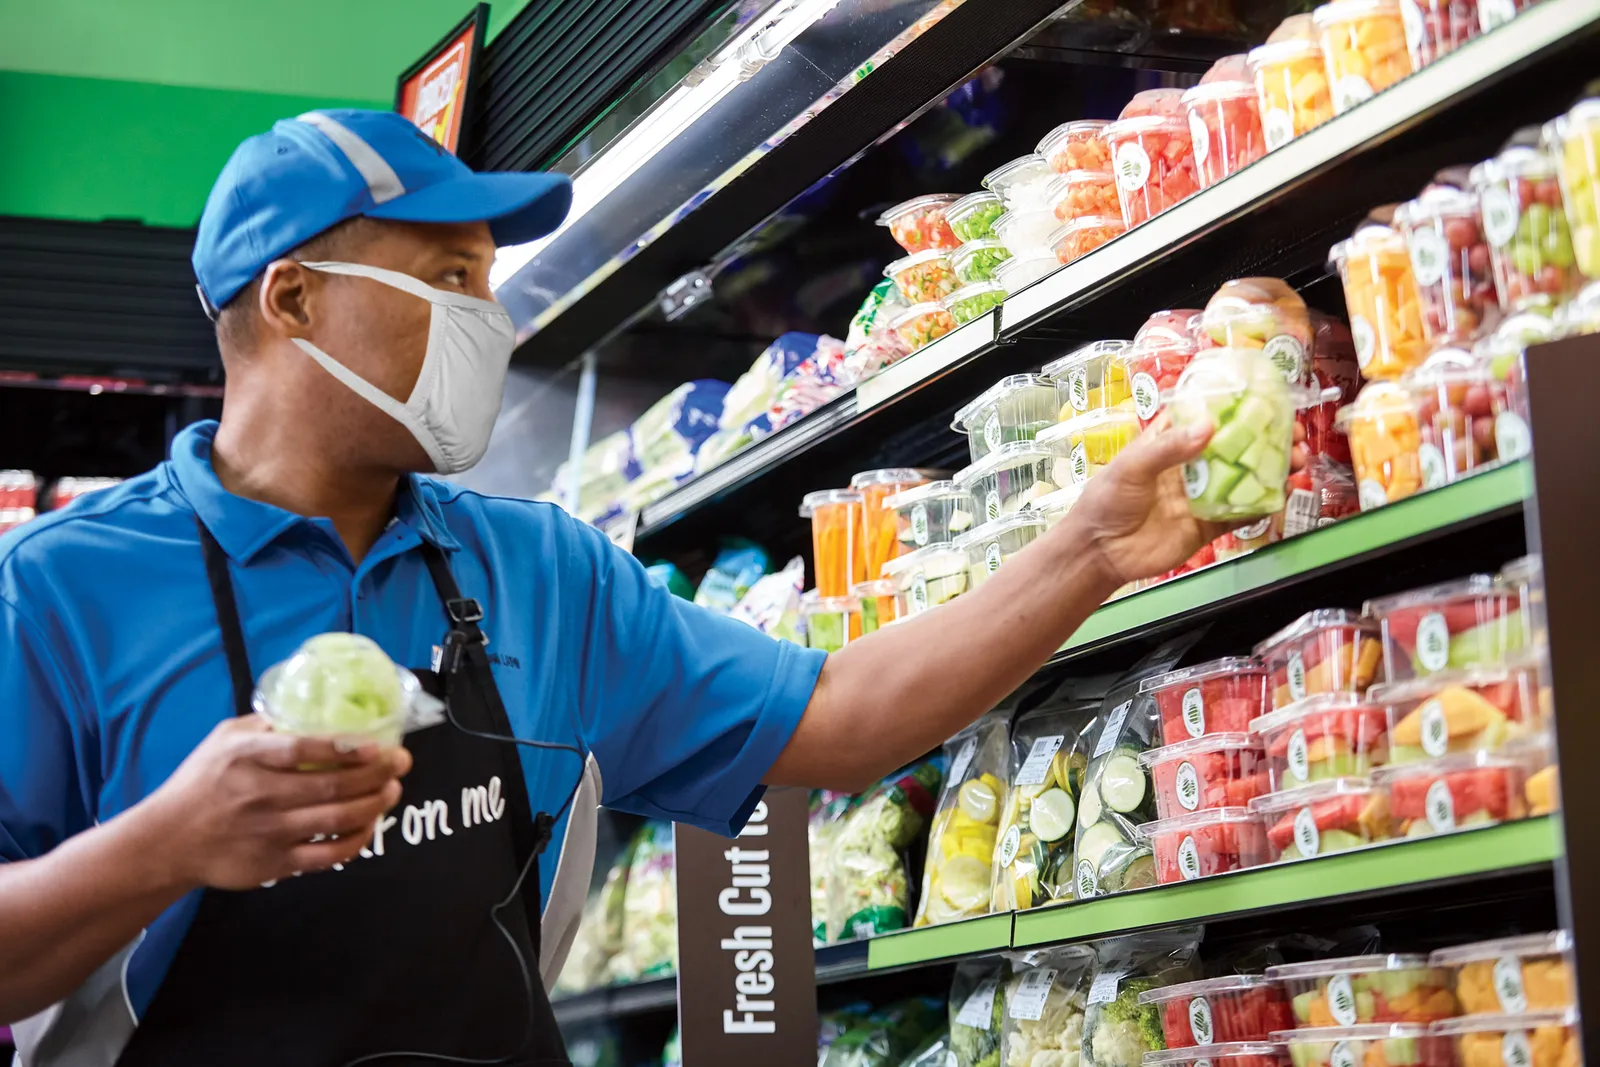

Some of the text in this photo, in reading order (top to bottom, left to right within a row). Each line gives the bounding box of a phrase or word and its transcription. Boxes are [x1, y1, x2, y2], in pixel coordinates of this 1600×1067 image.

[402, 776, 506, 845] on me
[718, 846, 772, 915] Cut
[721, 926, 776, 1033] Fresh
